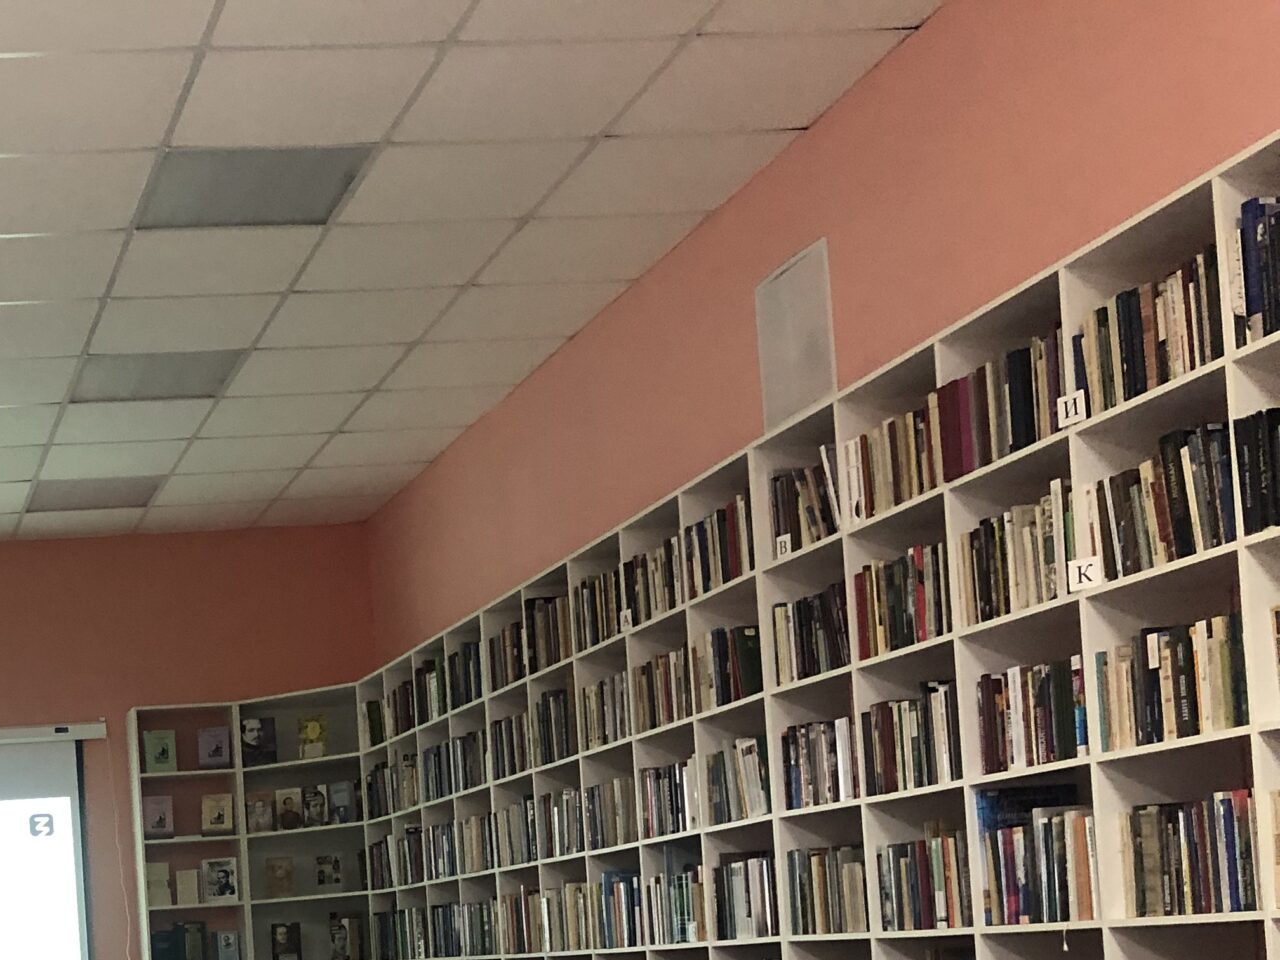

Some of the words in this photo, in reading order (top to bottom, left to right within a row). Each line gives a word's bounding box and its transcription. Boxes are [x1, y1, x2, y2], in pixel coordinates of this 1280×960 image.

[1063, 400, 1079, 420] И
[779, 540, 788, 556] В
[1076, 563, 1094, 583] К
[623, 615, 630, 626] А
